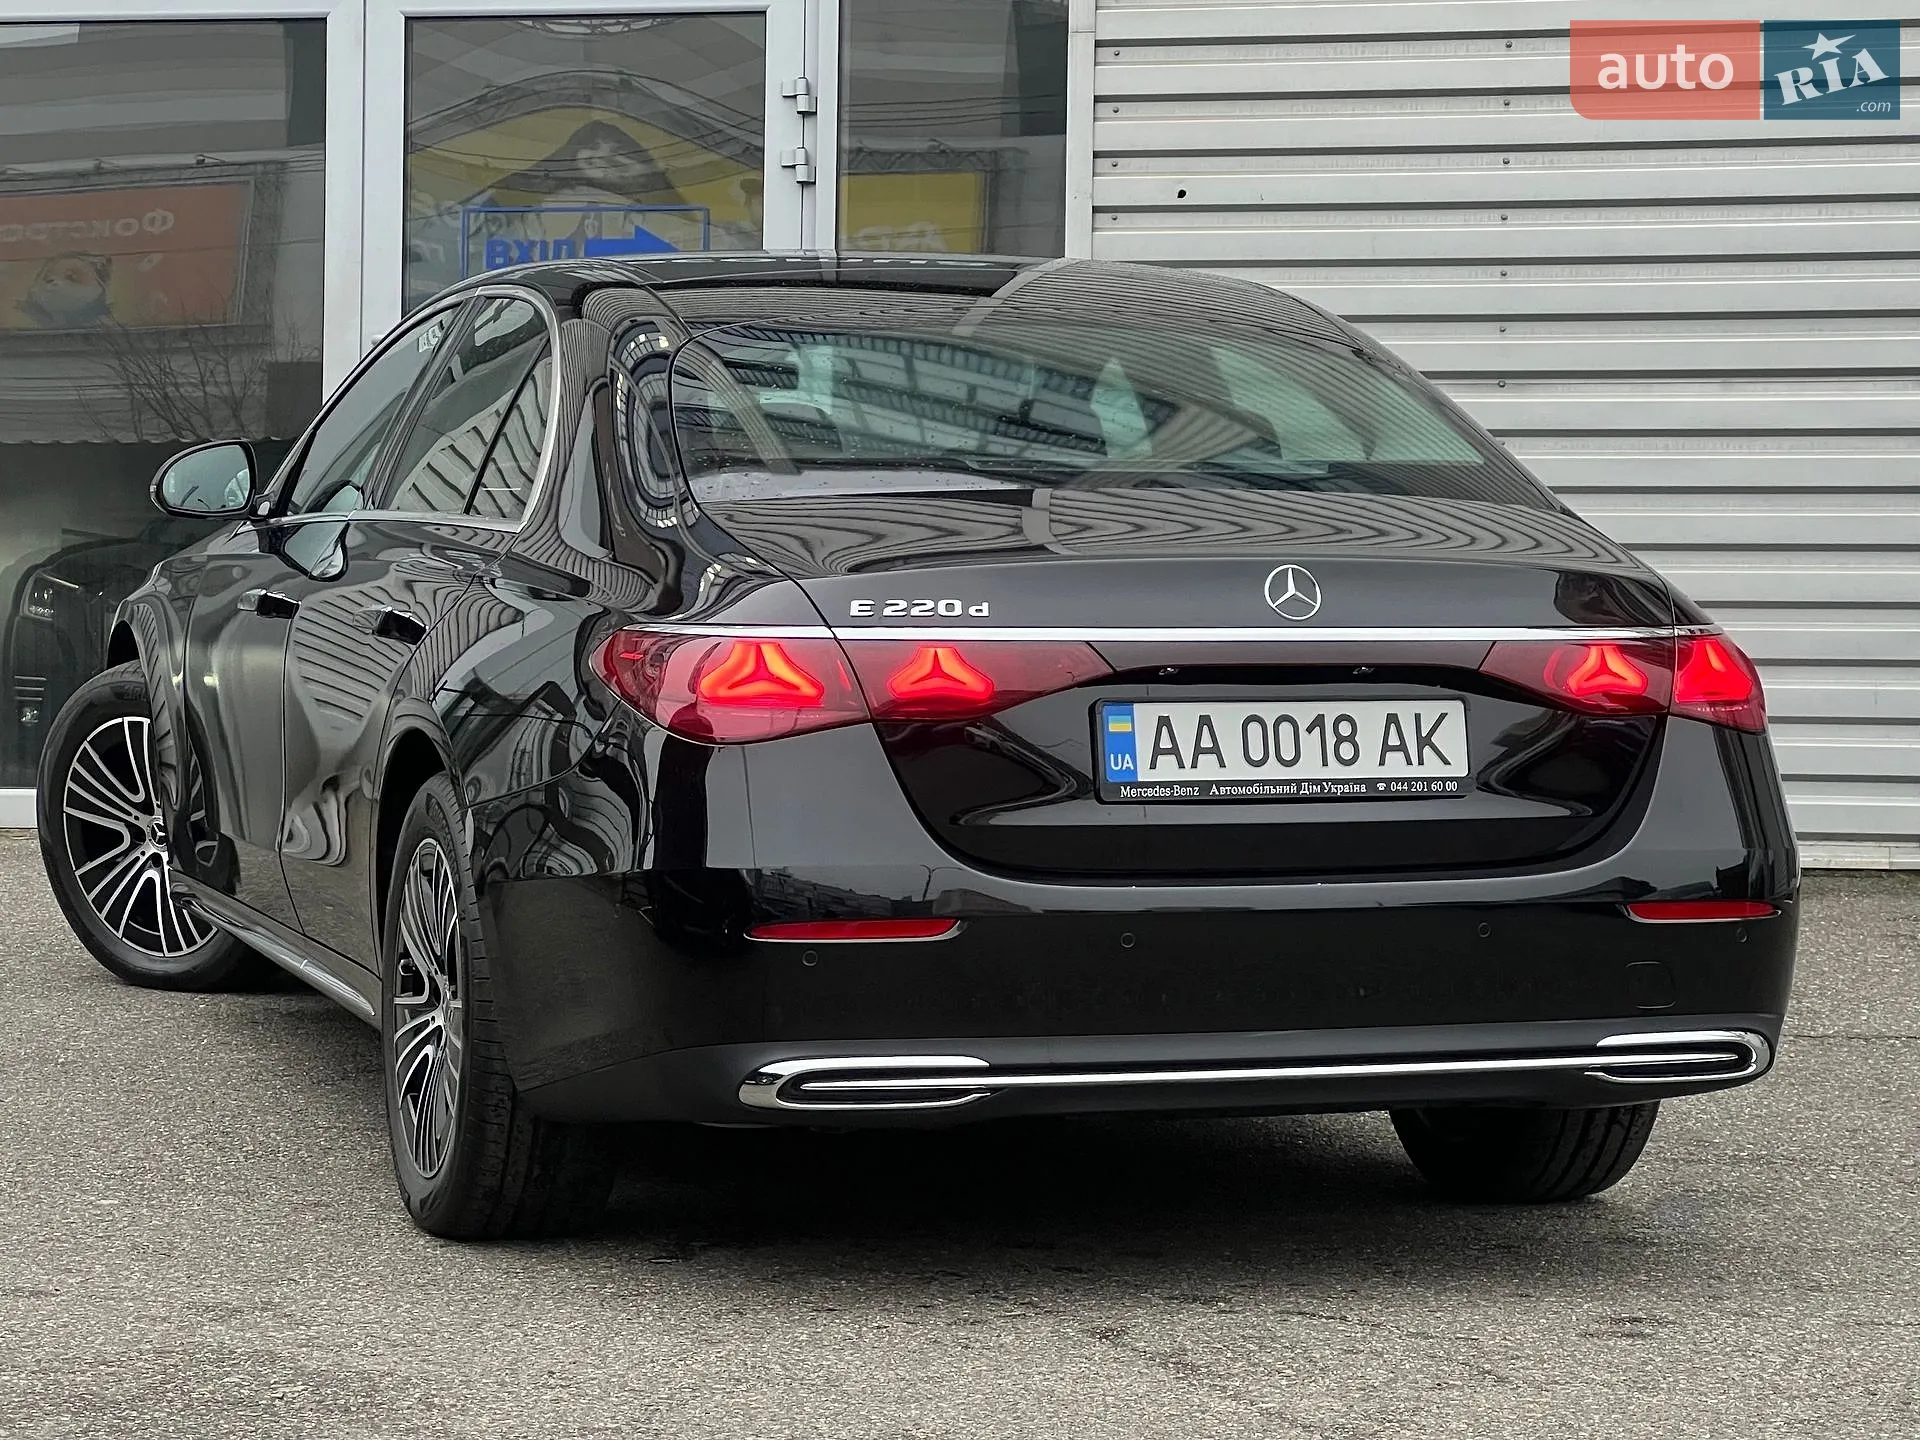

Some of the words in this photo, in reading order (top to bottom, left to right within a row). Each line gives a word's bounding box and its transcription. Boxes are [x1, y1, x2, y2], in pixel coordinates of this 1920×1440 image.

[850, 599, 875, 617] E
[882, 599, 963, 617] 220
[968, 601, 990, 617] d
[1149, 715, 1227, 770] AA
[1241, 713, 1360, 768] 0018
[1378, 712, 1452, 766] AK
[1110, 753, 1134, 772] UA
[1120, 784, 1200, 798] Mercedes-Benz
[1209, 782, 1297, 796] Автомобільний
[1299, 782, 1321, 795] Дім
[1323, 781, 1367, 795] Україна
[1390, 781, 1408, 792] 044
[1411, 781, 1428, 791] 201
[1431, 781, 1443, 791] 60
[1445, 780, 1458, 791] 00
